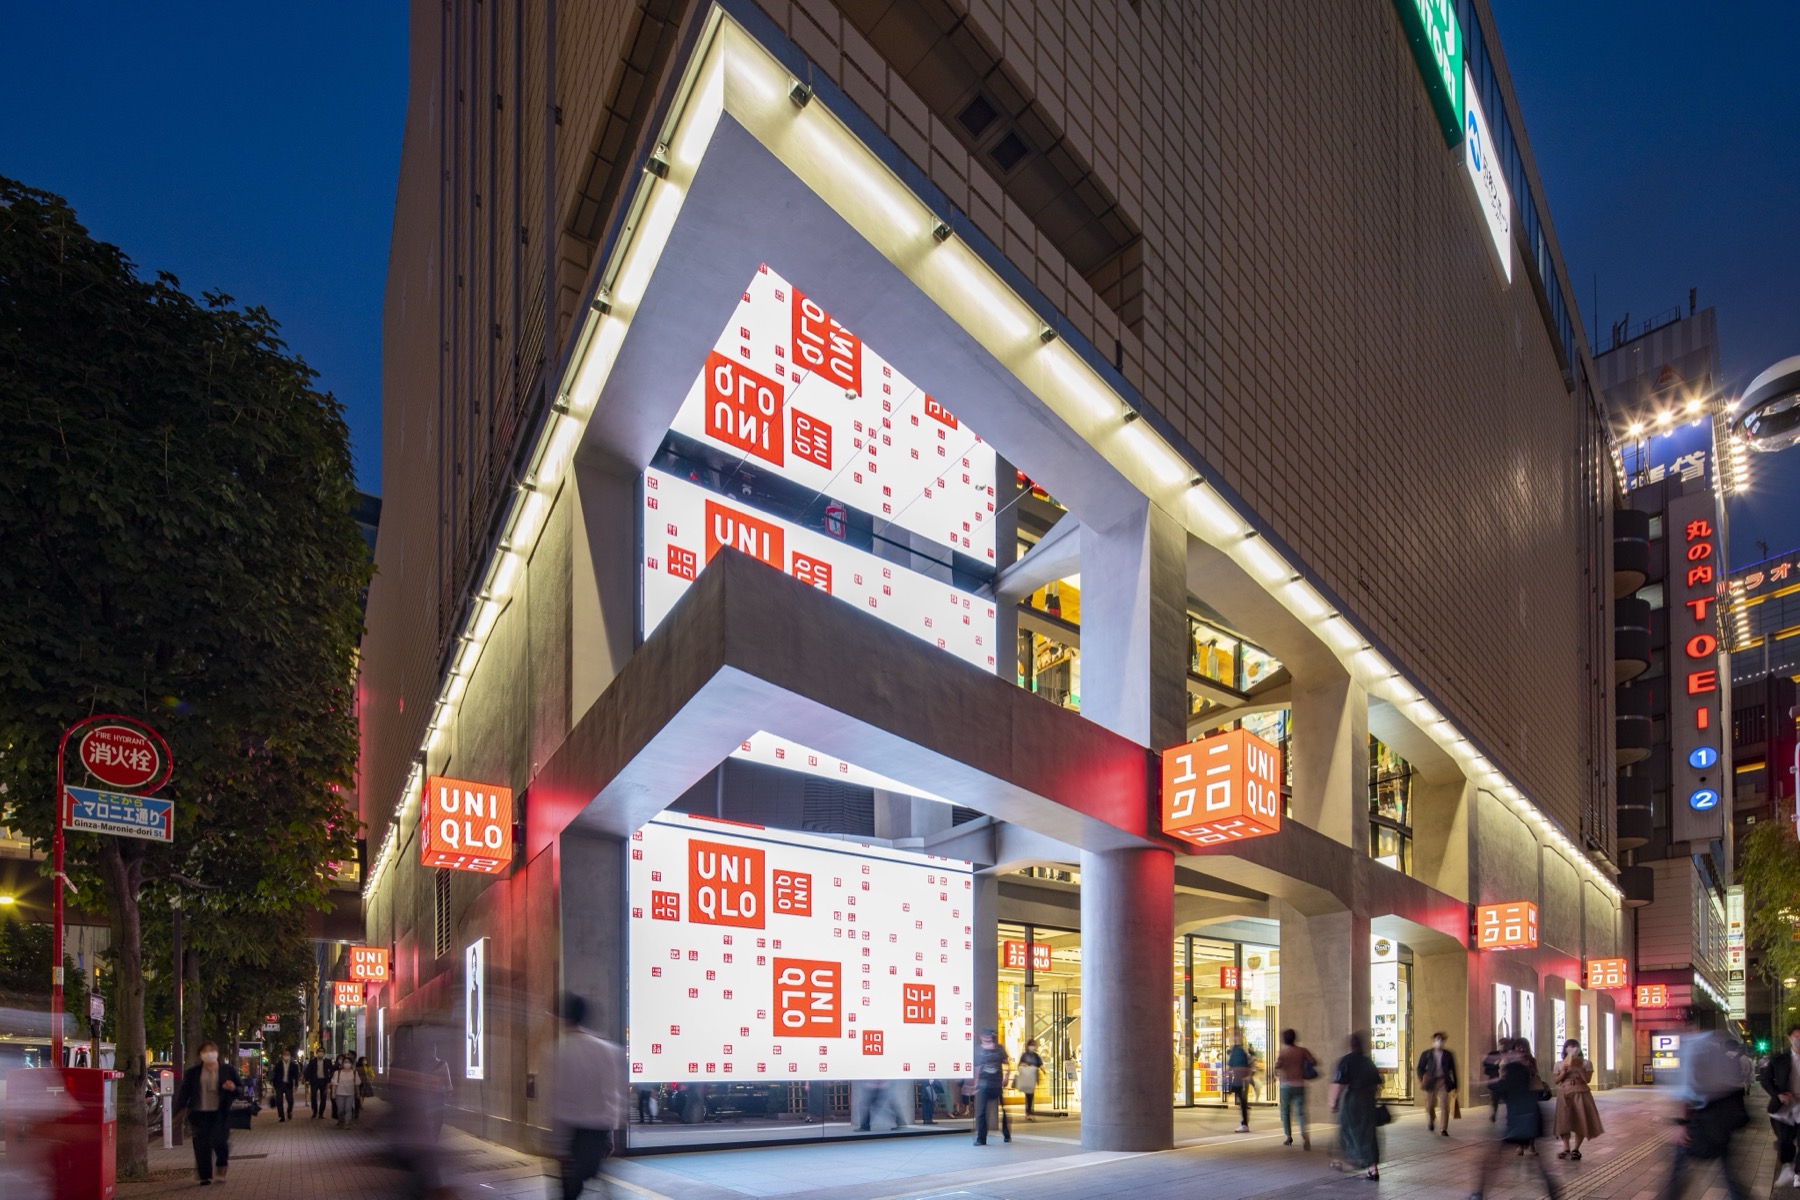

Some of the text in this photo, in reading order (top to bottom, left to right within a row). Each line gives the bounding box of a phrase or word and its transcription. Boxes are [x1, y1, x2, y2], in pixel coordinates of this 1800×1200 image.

[714, 514, 770, 561] UNI
[1686, 519, 1713, 587] 丸の内
[795, 559, 811, 582] QL
[813, 564, 828, 592] UN
[1686, 596, 1717, 730] TOEI
[95, 731, 145, 746] FIRE HYDRANT
[89, 741, 152, 772] 消火栓
[1173, 743, 1231, 785] ユニ
[1247, 742, 1274, 784] UNI
[83, 801, 160, 826] マロニエ通り
[98, 793, 143, 807] ここから
[440, 787, 497, 819] UNI
[1171, 779, 1231, 819] クロ
[1247, 780, 1276, 818] QLO
[74, 819, 164, 838] Ginza-Maronie-dori St.
[440, 818, 503, 849] QLO
[697, 851, 751, 885] UNI
[697, 885, 757, 920] QLO
[775, 875, 791, 910] QLO
[794, 877, 807, 909] UNI
[1484, 908, 1521, 926] ユニ
[1483, 925, 1521, 943] クロ
[355, 951, 382, 963] UNI
[1033, 946, 1048, 957] UNI
[1033, 957, 1050, 969] QLO
[355, 964, 385, 977] QLO
[338, 984, 358, 993] UNI
[338, 994, 360, 1003] QLO
[777, 967, 806, 1028] QLO
[810, 969, 833, 1023] UNI
[1660, 1037, 1673, 1049] P
